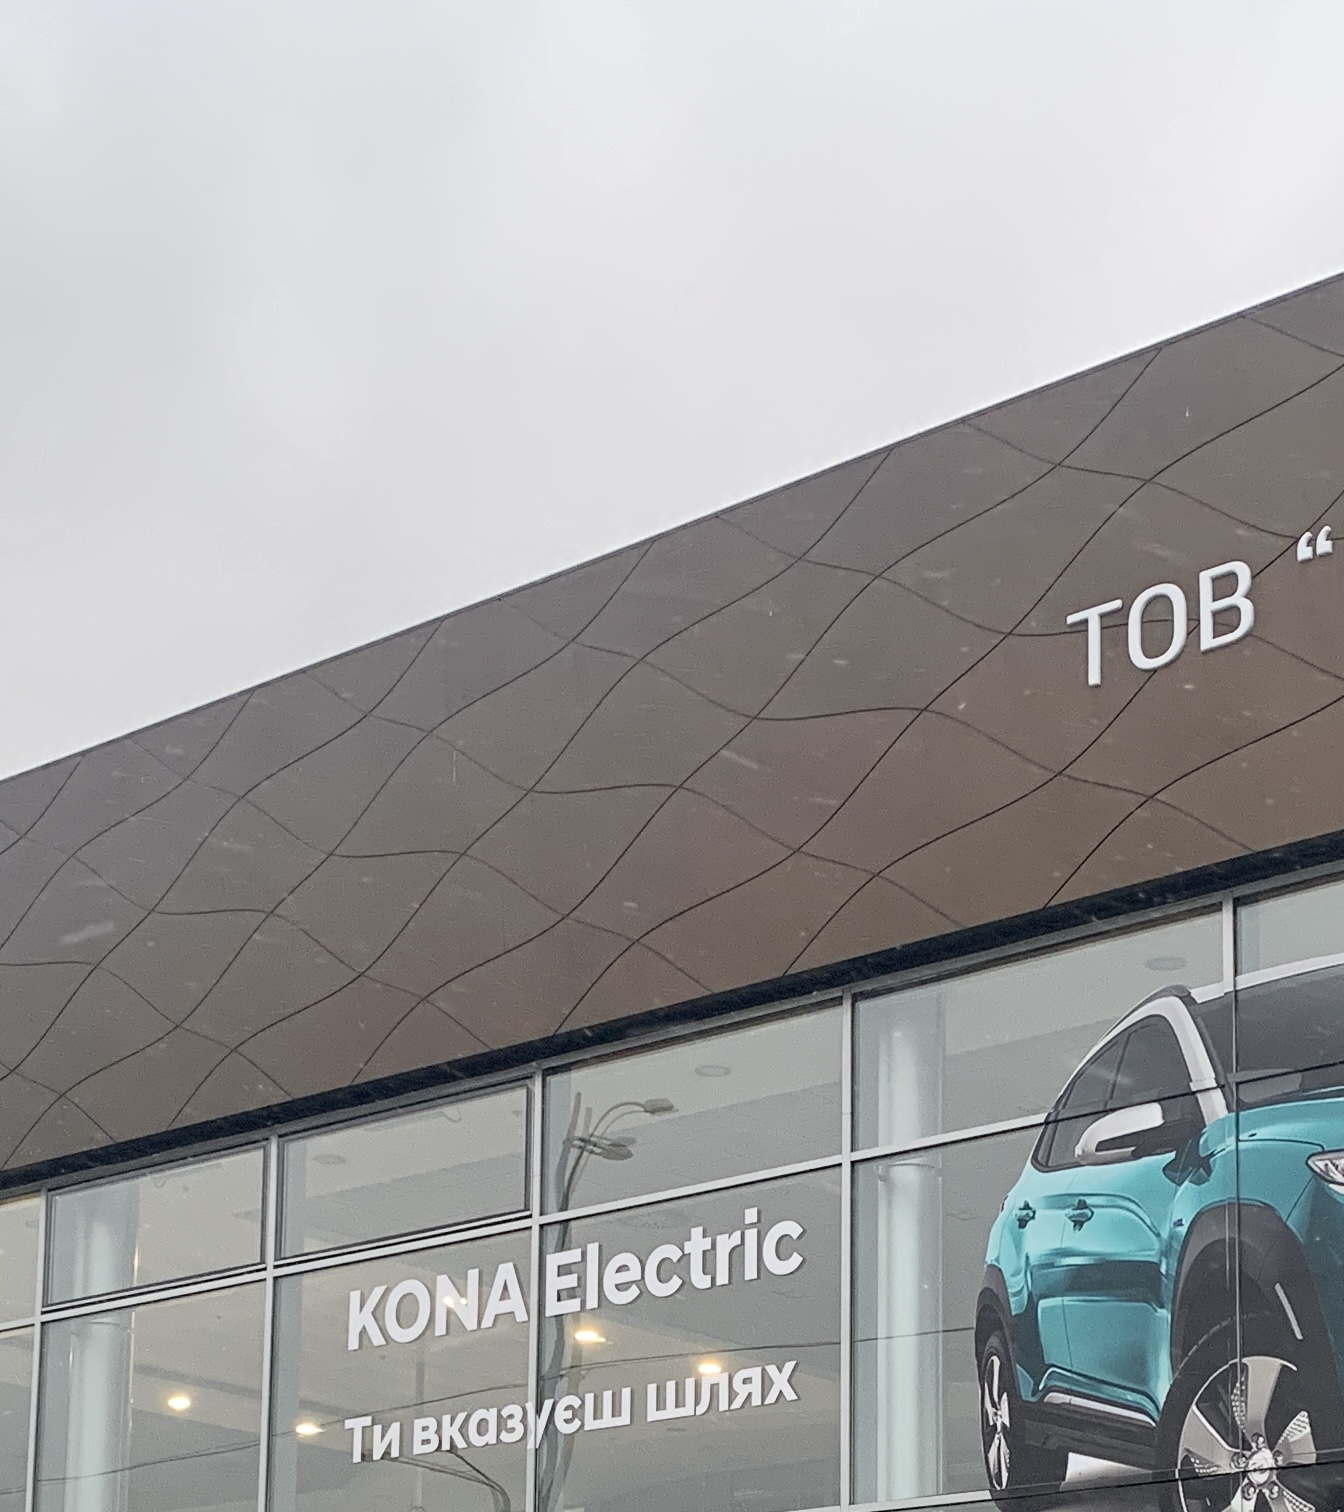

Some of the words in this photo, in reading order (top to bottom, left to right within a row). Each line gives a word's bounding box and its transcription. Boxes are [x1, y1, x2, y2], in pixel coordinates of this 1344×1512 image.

[1066, 561, 1256, 687] ТОВ
[347, 1261, 529, 1351] KONA
[545, 1206, 804, 1317] Electric
[344, 1416, 401, 1463] Ти
[412, 1386, 632, 1456] вказуєш
[646, 1360, 799, 1422] шлях
